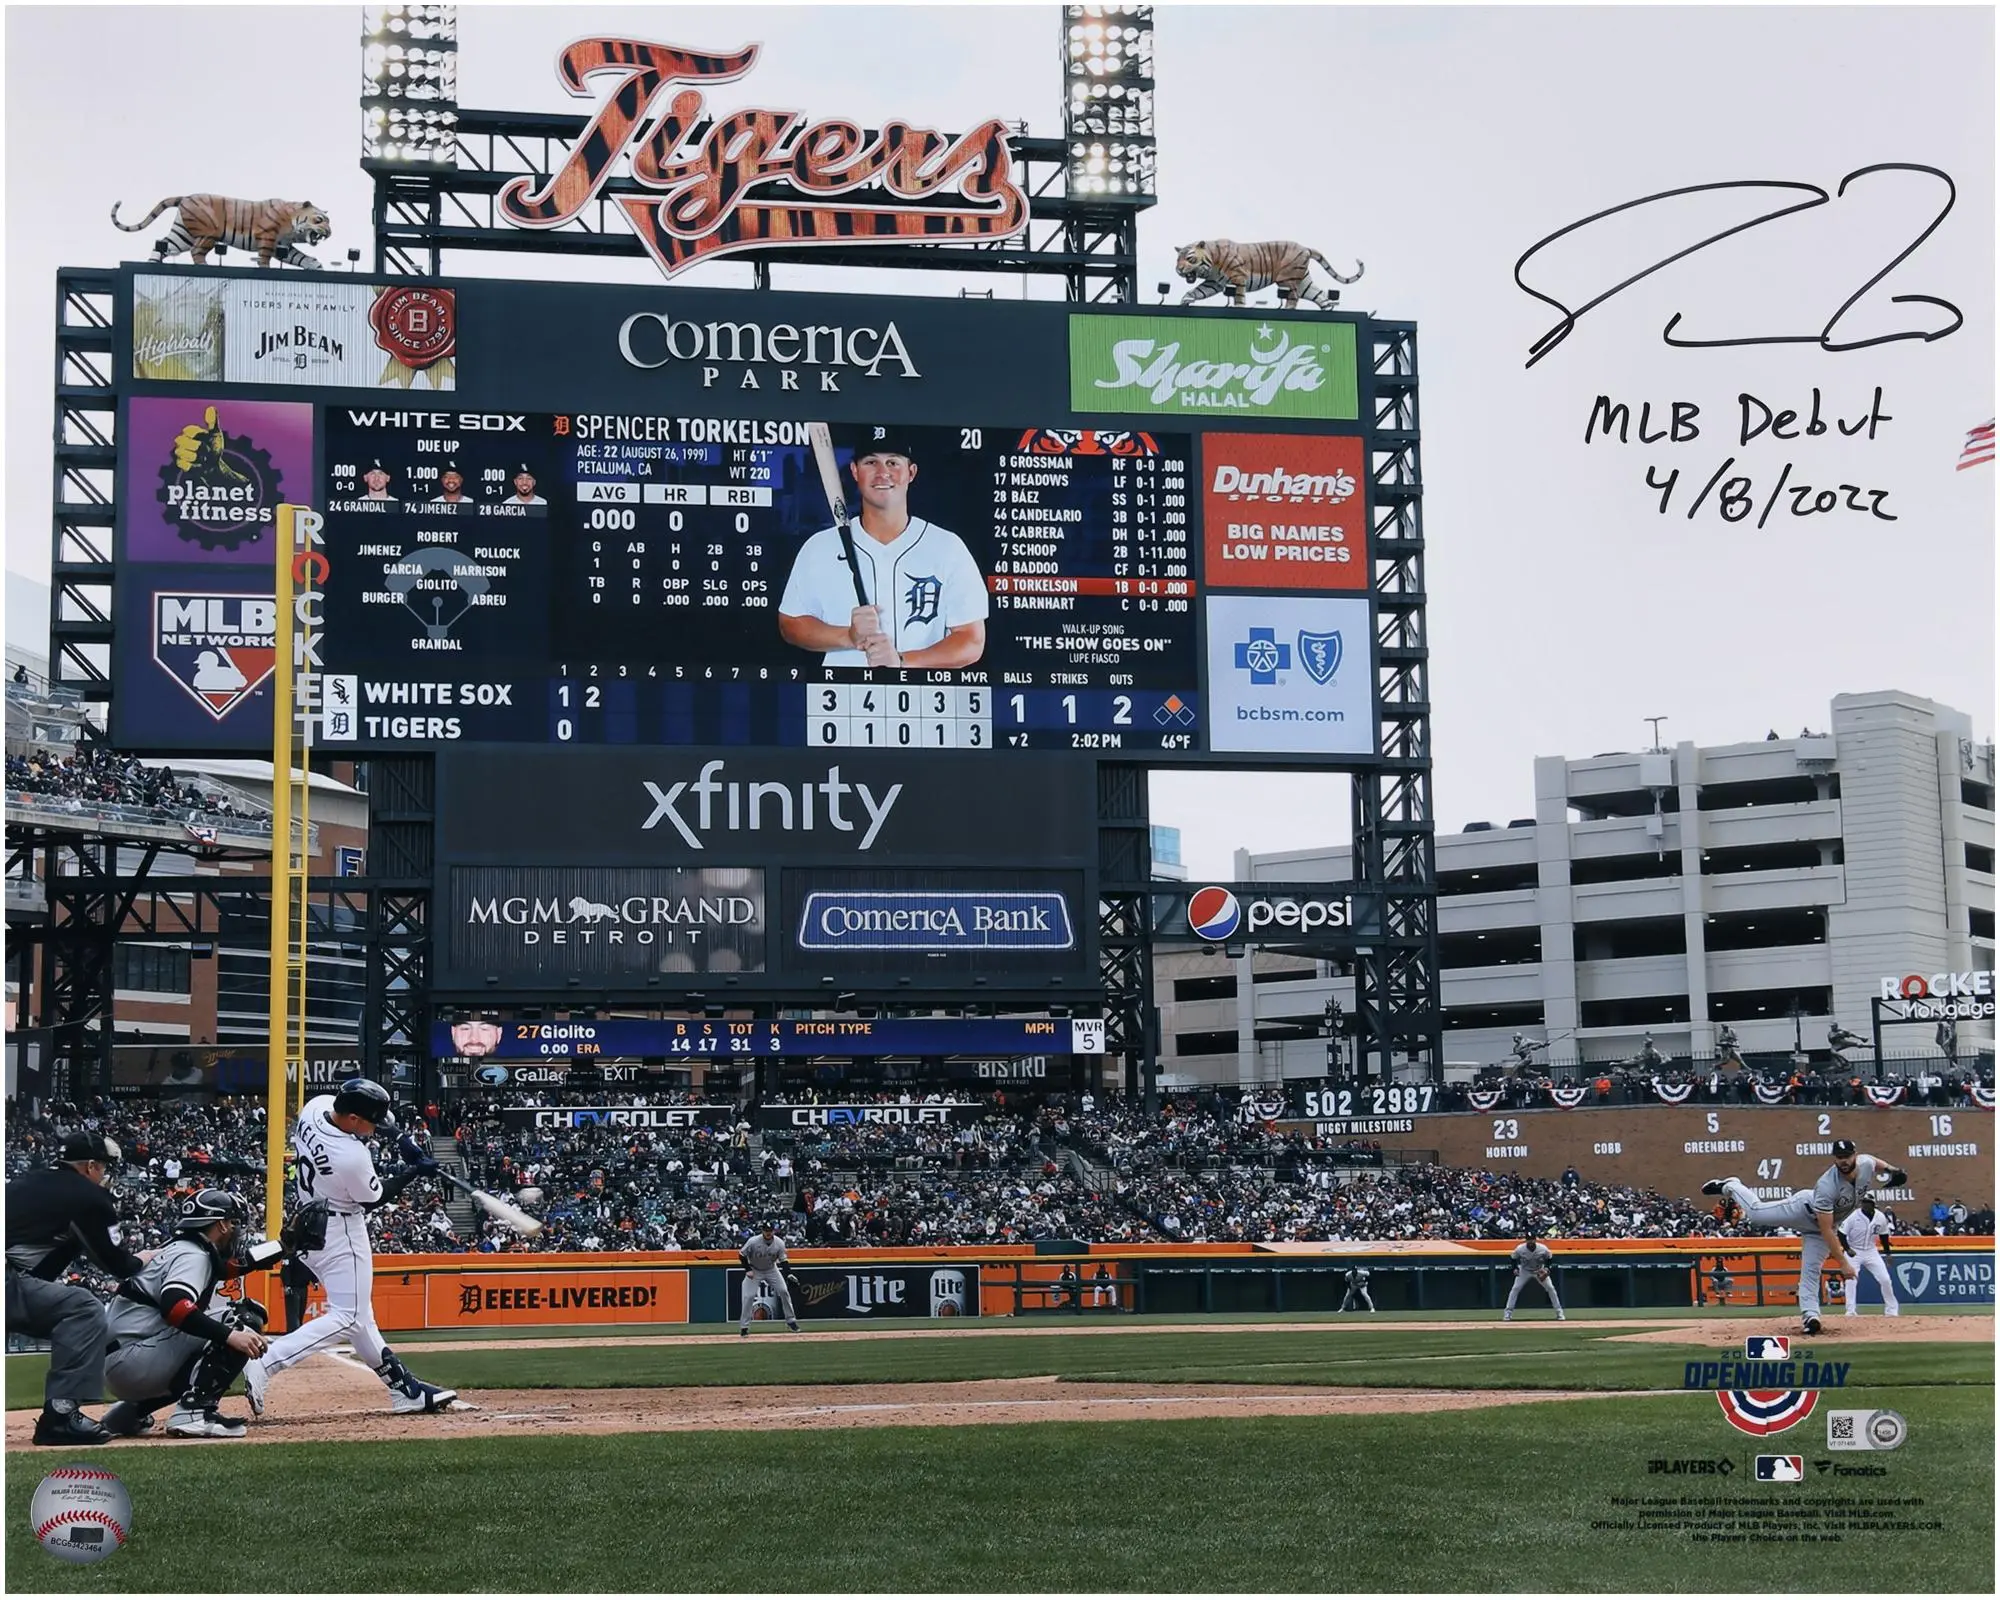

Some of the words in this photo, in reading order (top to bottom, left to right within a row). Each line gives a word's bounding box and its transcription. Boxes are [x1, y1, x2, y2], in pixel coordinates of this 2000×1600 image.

[496, 35, 1031, 281] Tigers
[243, 300, 282, 310] TIGERS
[289, 302, 310, 311] FAN
[391, 295, 409, 313] JIM
[412, 292, 446, 316] BEAM
[409, 309, 428, 332] B
[254, 331, 289, 360] JIM
[294, 325, 343, 361] BEAM
[389, 322, 421, 349] SINCE
[425, 324, 447, 347] 1795
[135, 329, 217, 363] Highball
[703, 366, 841, 392] PARK
[1094, 338, 1326, 405] Sharifa
[1181, 391, 1250, 408] HALAL
[348, 410, 451, 429] WHITE
[459, 414, 527, 432] SOX
[1585, 395, 1701, 444] MLB
[1738, 386, 1893, 446] Debut
[576, 415, 671, 441] SPENCER
[676, 417, 810, 446] TORKELSON
[417, 439, 441, 452] DUE
[443, 440, 460, 453] UP
[577, 445, 600, 458] AGE:
[603, 445, 618, 458] 22
[621, 446, 661, 460] (AUGUST
[664, 447, 679, 461] 26,
[682, 448, 708, 462] 1999)
[733, 449, 746, 462] HT
[1009, 455, 1073, 470] GROSSMAN
[577, 461, 635, 477] PETALUMA,
[638, 462, 653, 476] CA
[729, 466, 746, 479] WT
[749, 467, 770, 480] 220
[1011, 473, 1069, 487] MEADOWS
[1213, 465, 1356, 497] Dunham's
[167, 480, 255, 505] planet
[592, 486, 626, 500] AVG
[664, 488, 687, 502] HR
[728, 490, 756, 504] RBI
[1011, 488, 1040, 504] BÁEZ
[1228, 495, 1346, 505] SPORTS
[1645, 457, 1898, 529] 4/8/2022
[180, 501, 273, 522] fitness
[329, 501, 342, 512] 24
[343, 501, 387, 513] GRANDAL
[404, 502, 417, 514] 74
[418, 502, 458, 515] JIMENEZ
[479, 504, 492, 516] 28
[493, 505, 526, 517] GARCIA
[1011, 509, 1082, 523] CANDELARIO
[417, 531, 459, 543] ROBERT
[1011, 526, 1065, 540] CABRERA
[1227, 524, 1264, 540] BIG
[1271, 525, 1345, 542] NAMES
[357, 544, 402, 556] JIMENEZ
[474, 547, 521, 559] POLLOCK
[1012, 543, 1057, 557] SCHOOP
[1222, 544, 1268, 560] LOW
[1274, 545, 1350, 562] PRICES
[383, 563, 423, 576] GARCIA
[453, 565, 507, 577] HARRISON
[1012, 560, 1059, 574] BADDOO
[416, 579, 458, 591] GIOLITO
[1013, 578, 1078, 592] TORKELSON
[362, 592, 404, 604] BURGER
[471, 594, 507, 606] ABREU
[1013, 596, 1075, 611] BARNHART
[161, 598, 277, 634] MLB
[291, 509, 331, 748] ROCKET
[1062, 623, 1101, 635] WALK-UP
[1102, 624, 1125, 635] SONG
[161, 634, 277, 647] NETWORK
[411, 638, 463, 650] GRANDAL
[1015, 635, 1052, 650] "THE
[1055, 636, 1098, 651] SHOW
[1102, 637, 1139, 651] GOES
[1143, 638, 1172, 652] ON"
[1069, 652, 1090, 664] LUPE
[1092, 653, 1120, 665] FIASCO
[1003, 672, 1033, 685] BALLS
[1050, 673, 1089, 685] STRIKES
[1109, 674, 1134, 686] OUTS
[363, 681, 453, 706] WHITE
[458, 683, 513, 706] SOX
[1237, 705, 1345, 722] bcbsm.com
[364, 716, 462, 739] TIGERS
[1072, 734, 1099, 748] 2:02
[1101, 734, 1121, 749] PM
[1161, 734, 1191, 750] 46°F
[641, 759, 904, 851] xfinity
[468, 896, 562, 925] MGM
[1247, 895, 1353, 934] pepsi
[974, 906, 1052, 936] Bank
[524, 930, 702, 945] DETROIT
[1901, 1001, 1995, 1019] Mortgage
[517, 1025, 540, 1040] 27
[540, 1024, 596, 1040] Giolito
[795, 1023, 835, 1035] PITCH
[839, 1023, 872, 1035] TYPE
[1025, 1022, 1055, 1034] MPH
[576, 1043, 601, 1054] ERA
[603, 1066, 639, 1082] EXIT
[978, 1056, 1046, 1078] BISTRO
[1305, 1090, 1352, 1117] 502
[1372, 1086, 1434, 1115] 2987
[535, 1109, 700, 1128] CHEVROLET
[791, 1108, 951, 1126] CHEVROLET
[1706, 1112, 1720, 1134] 5
[1817, 1113, 1832, 1135] 2
[1316, 1121, 1347, 1135] MIGGY
[1351, 1119, 1413, 1134] MILESTONES
[1493, 1119, 1519, 1141] 23
[1929, 1114, 1953, 1137] 16
[1486, 1145, 1528, 1158] HORTON
[1593, 1142, 1622, 1155] COBB
[1684, 1140, 1745, 1153] GREENBERG
[1908, 1143, 1978, 1158] NEWHOUSER
[1757, 1158, 1783, 1181] 47
[801, 1279, 846, 1306] Miller
[845, 1274, 906, 1313] Lite
[934, 1279, 964, 1298] Lite
[1938, 1284, 1995, 1296] SPORTS
